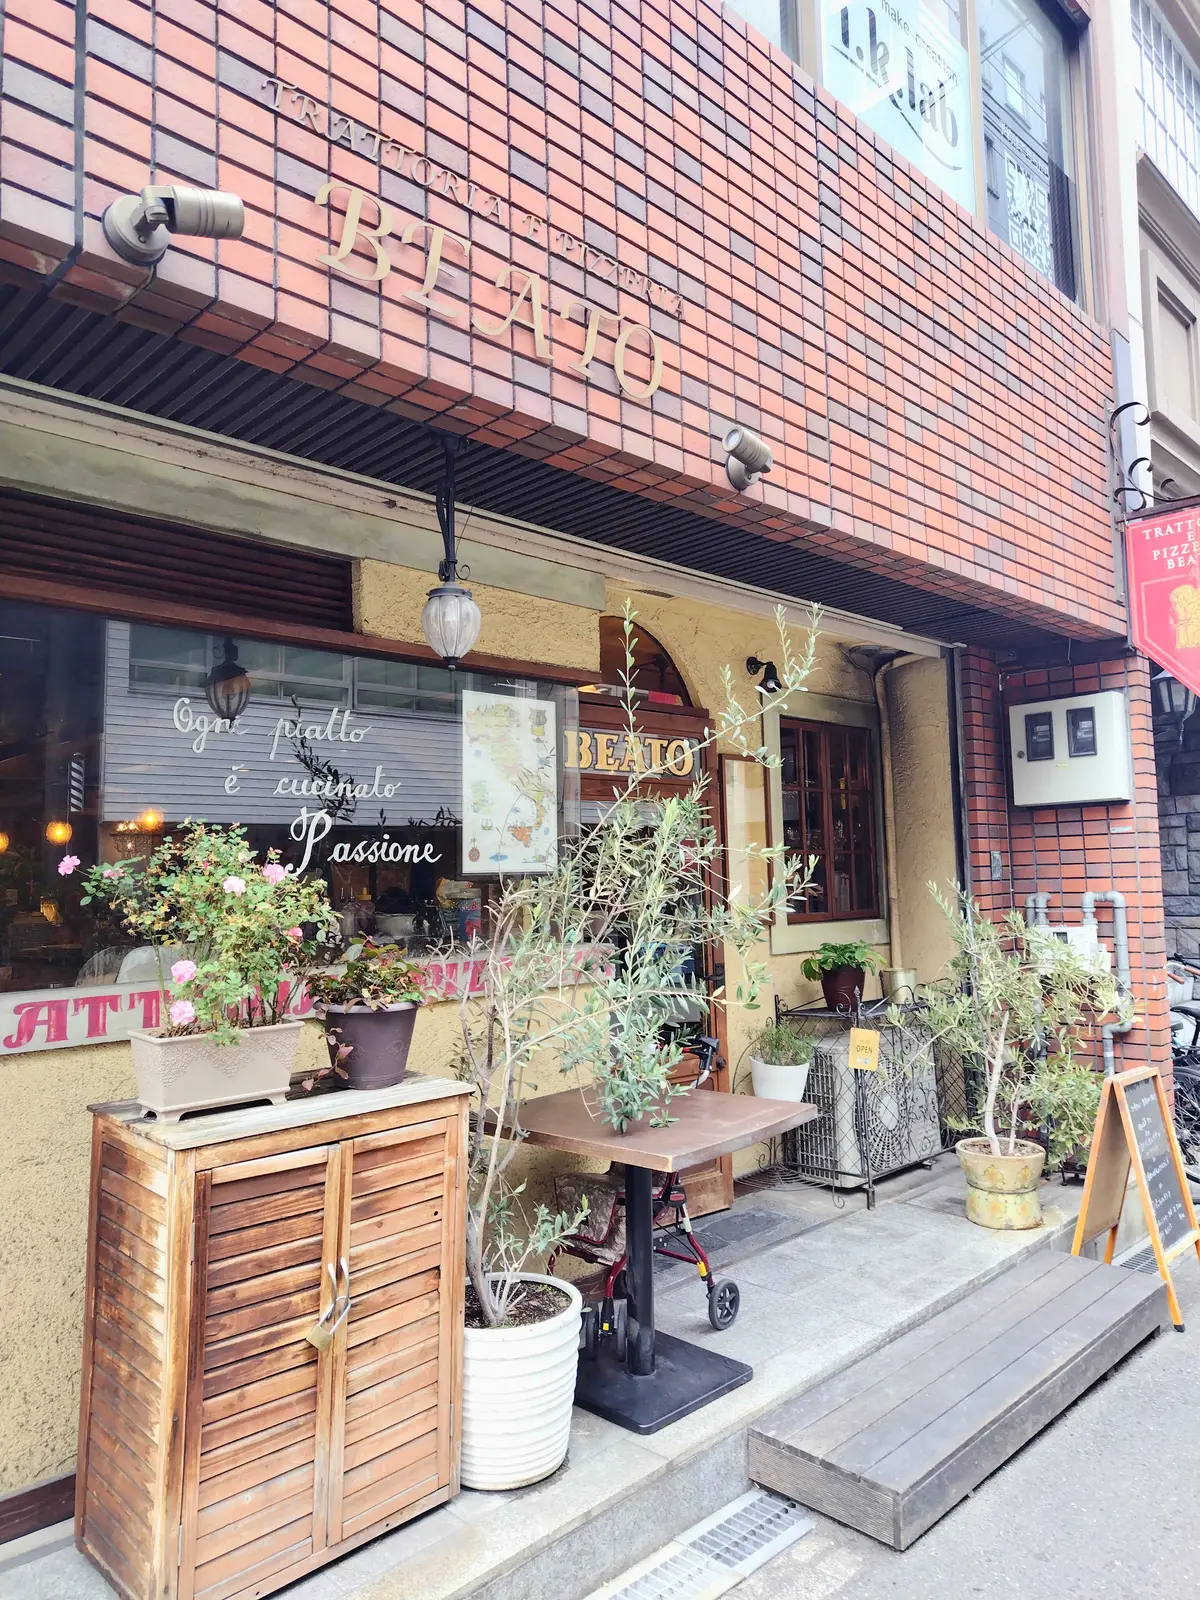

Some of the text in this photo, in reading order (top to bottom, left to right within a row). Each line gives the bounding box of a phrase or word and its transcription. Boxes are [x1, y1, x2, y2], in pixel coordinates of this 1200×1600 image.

[881, 0, 910, 34] make
[261, 78, 687, 322] TRATTORIA E PIZZERIA
[314, 182, 664, 400] BEATO
[1187, 531, 1195, 542] E
[173, 697, 373, 760] Ogni piatto
[563, 729, 694, 777] BEATO
[273, 764, 402, 799] cucinato
[284, 806, 443, 877] Passione
[856, 1044, 873, 1055] OPEN
